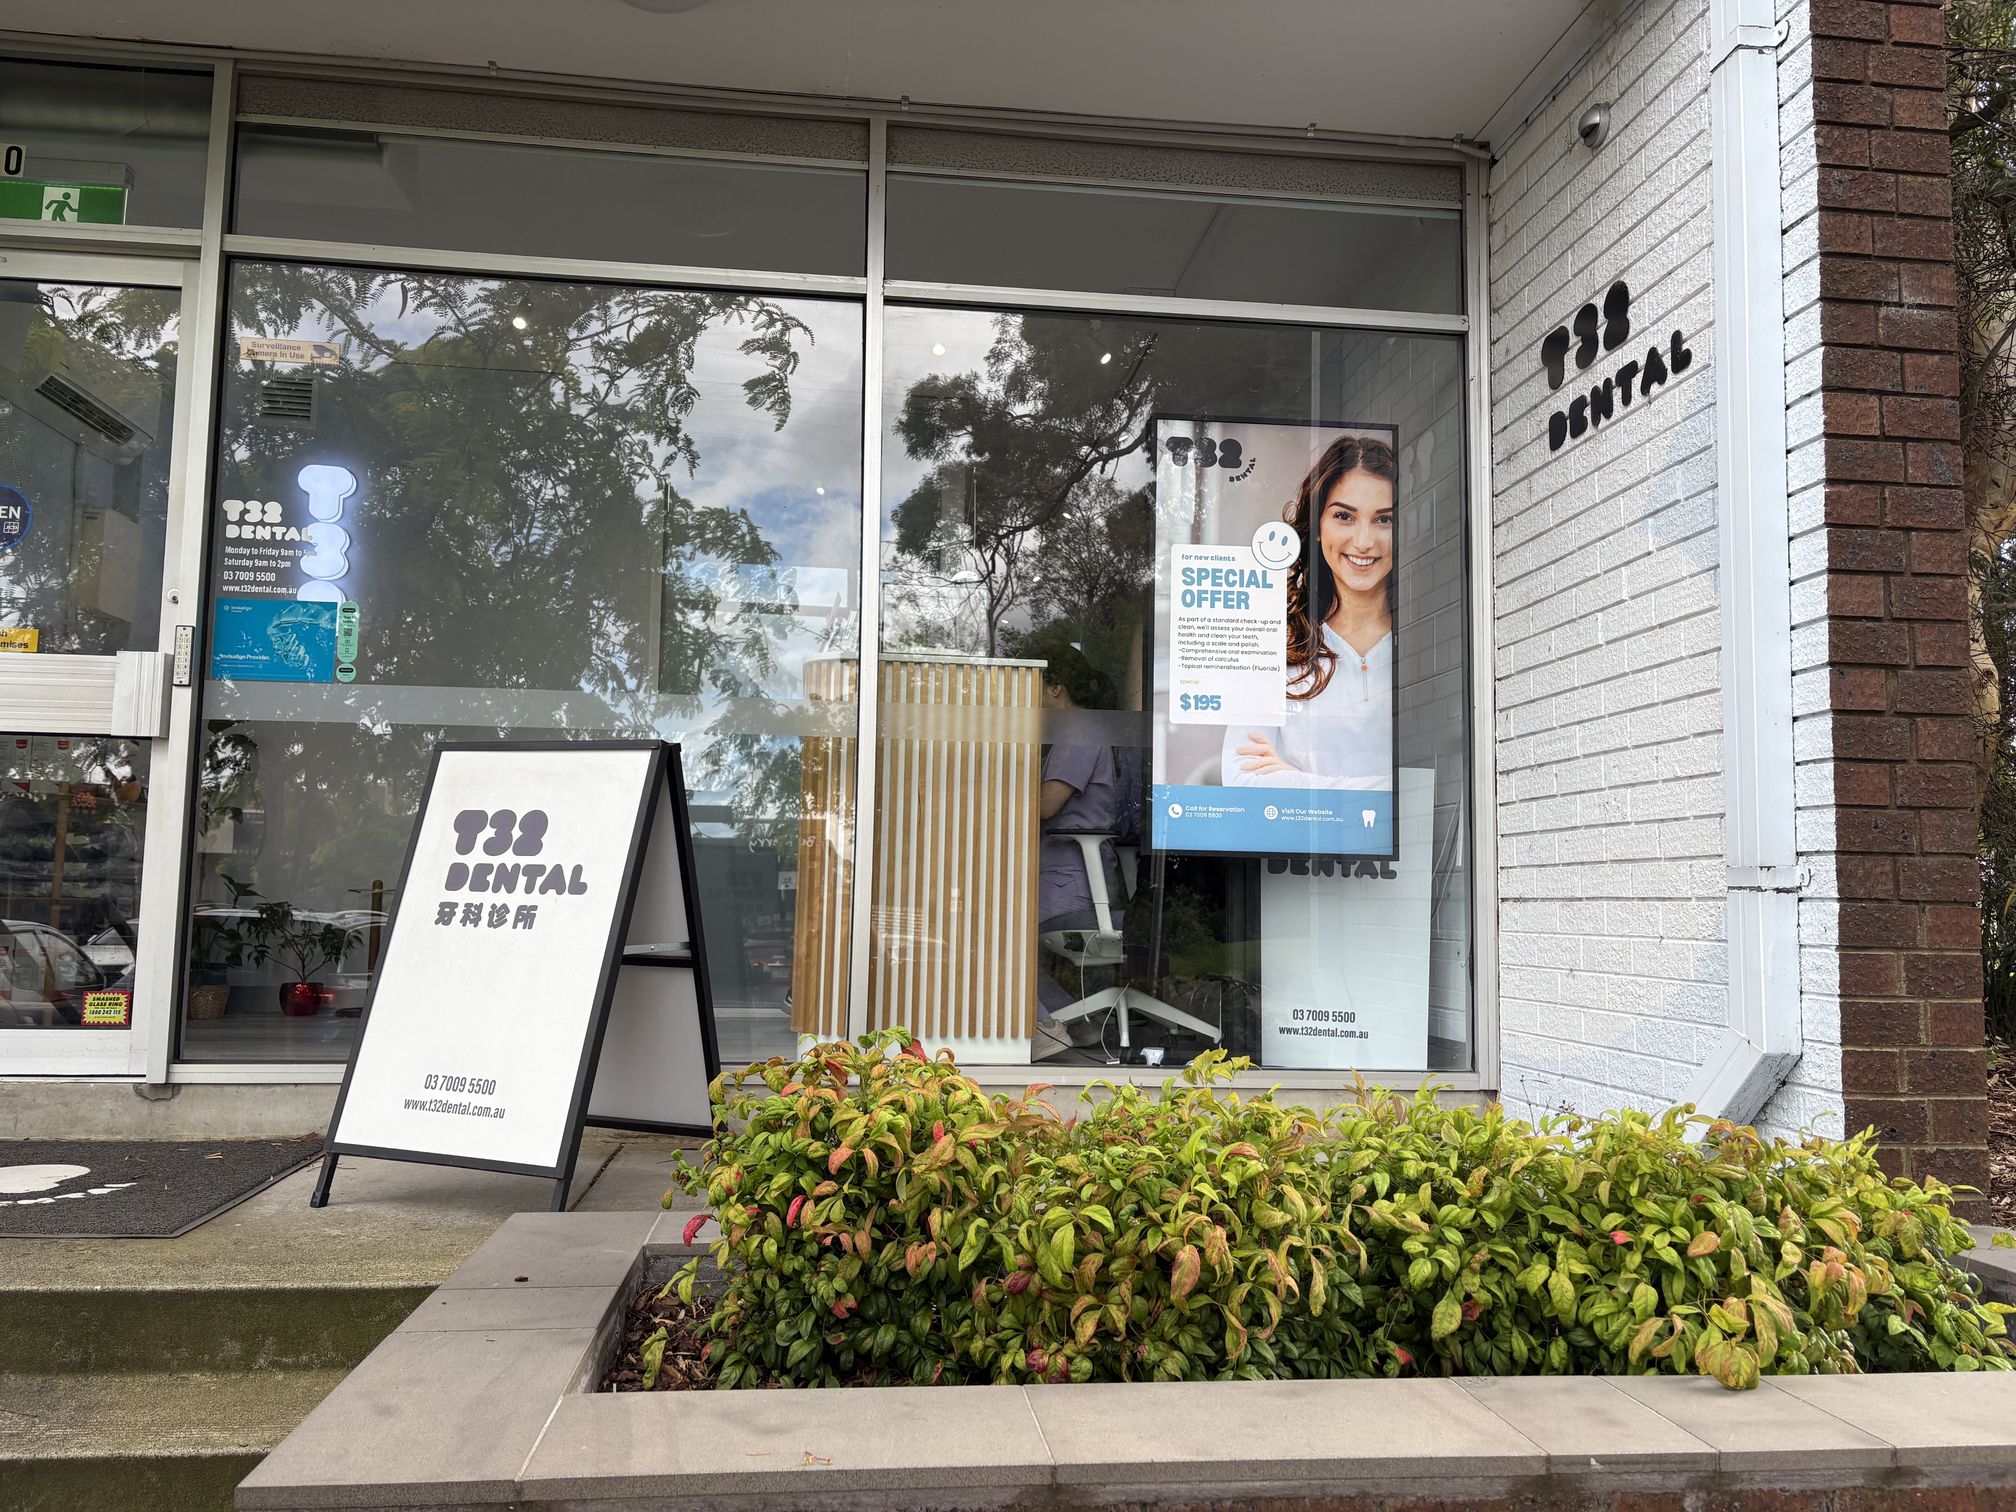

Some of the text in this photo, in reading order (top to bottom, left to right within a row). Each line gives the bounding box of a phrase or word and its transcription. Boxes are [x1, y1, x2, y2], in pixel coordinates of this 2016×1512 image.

[4, 146, 22, 176] 0
[1541, 280, 1630, 390] T32
[252, 342, 301, 351] Surveillance
[1549, 330, 1692, 451] DENTAL
[1166, 436, 1242, 468] T32
[1229, 457, 1256, 482] DENTAL
[222, 500, 282, 523] T32
[226, 525, 312, 542] DENTAL
[225, 546, 250, 556] Monday
[259, 548, 280, 557] Friday
[1182, 554, 1193, 562] for
[1210, 554, 1236, 562] clients
[224, 558, 253, 568] Saturday
[277, 560, 291, 568] 2pm
[224, 571, 276, 582] 03 7009 5500
[1182, 566, 1274, 588] SPECIAL
[222, 585, 296, 594] www.t32dental.com.au
[1182, 589, 1250, 610] OFFER
[1180, 693, 1222, 712] $195
[454, 809, 548, 856] T32
[444, 862, 588, 895] DENTAL
[1268, 858, 1397, 880] DENTAL
[434, 902, 538, 930] 牙科诊所
[1292, 1008, 1356, 1023] 03 7009 5500
[1279, 1025, 1368, 1039] www.t32dental.com.au
[424, 1074, 496, 1096] 03 7009 5500
[404, 1098, 505, 1120] www.t32dental.com.au
